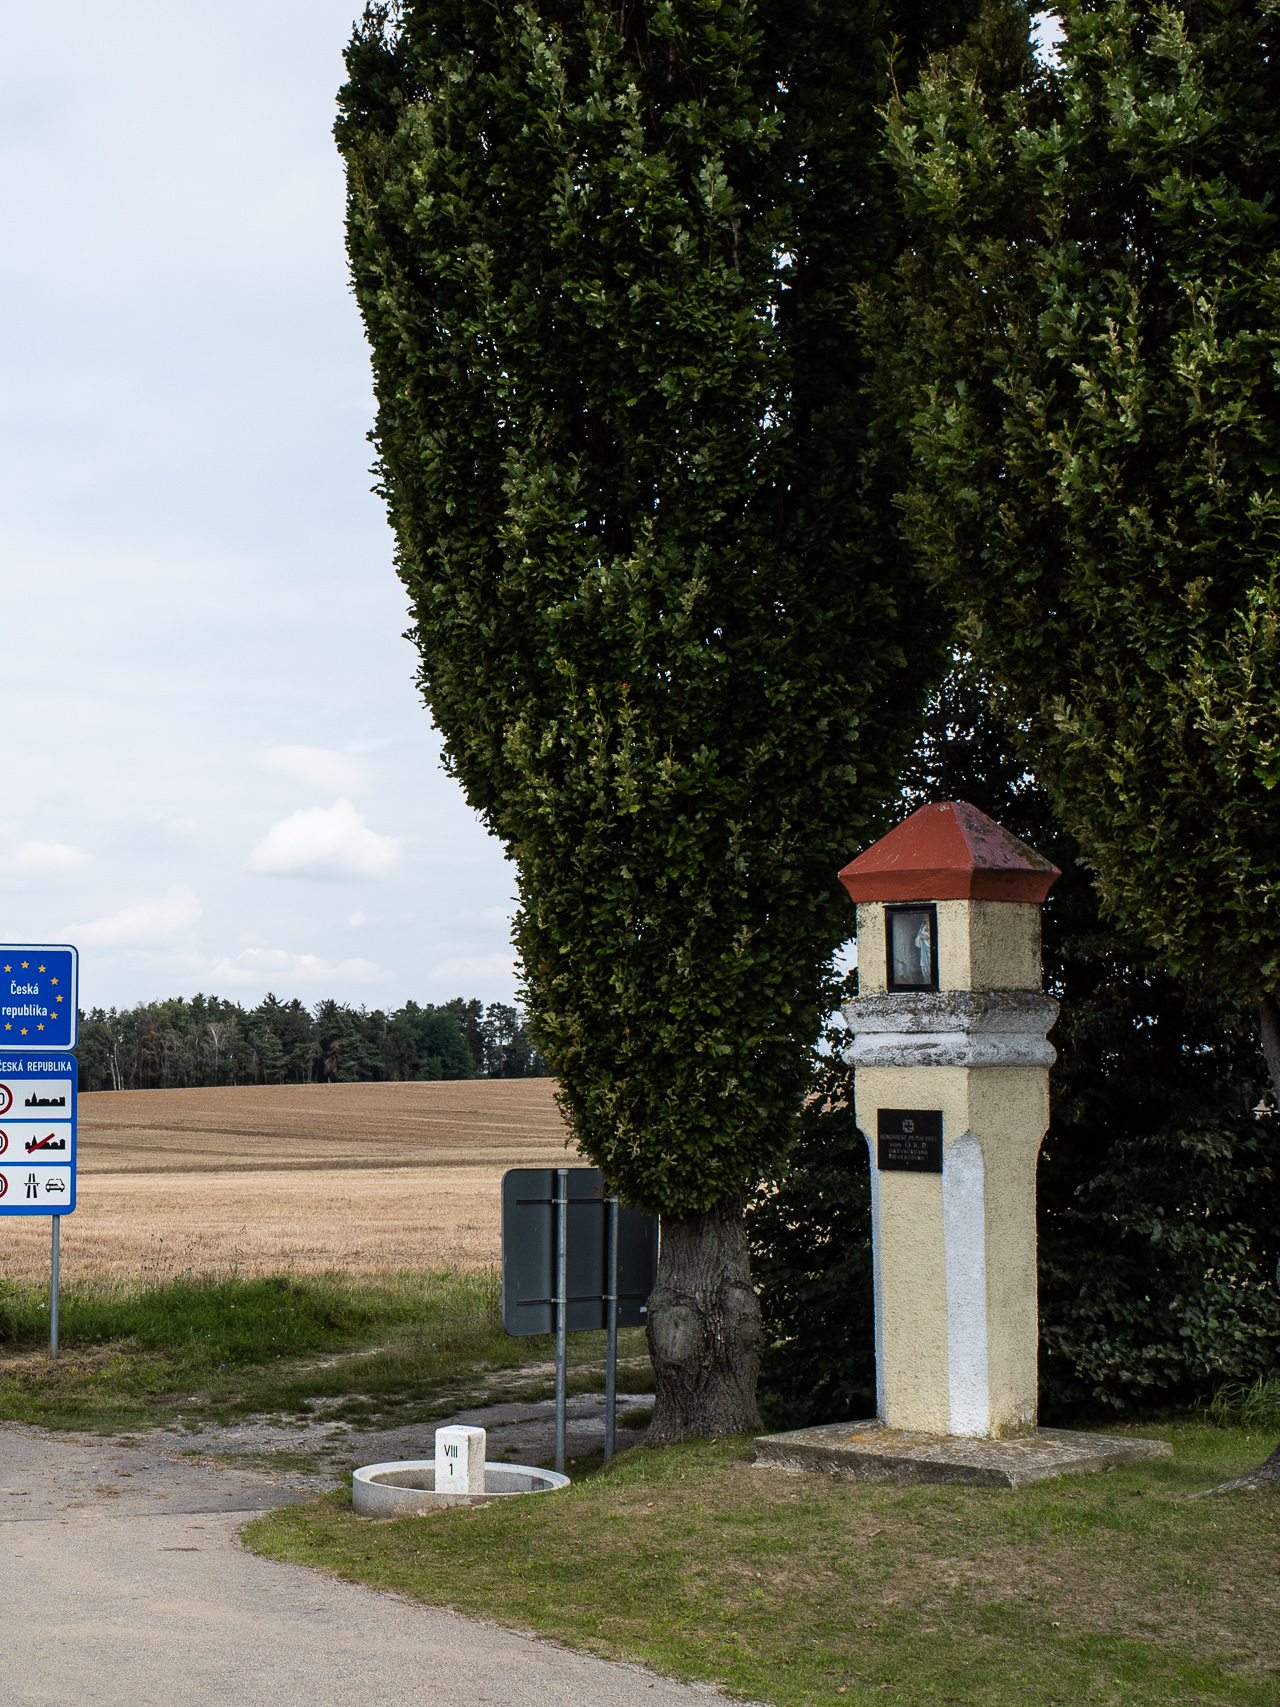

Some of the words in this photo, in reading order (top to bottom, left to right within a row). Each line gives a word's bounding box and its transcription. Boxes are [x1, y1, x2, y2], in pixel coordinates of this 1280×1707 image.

[10, 980, 39, 995] Česká
[1, 1004, 48, 1019] republika
[27, 1061, 72, 1072] REPUBLIKA
[443, 1443, 458, 1458] VIII
[448, 1462, 454, 1476] 1
